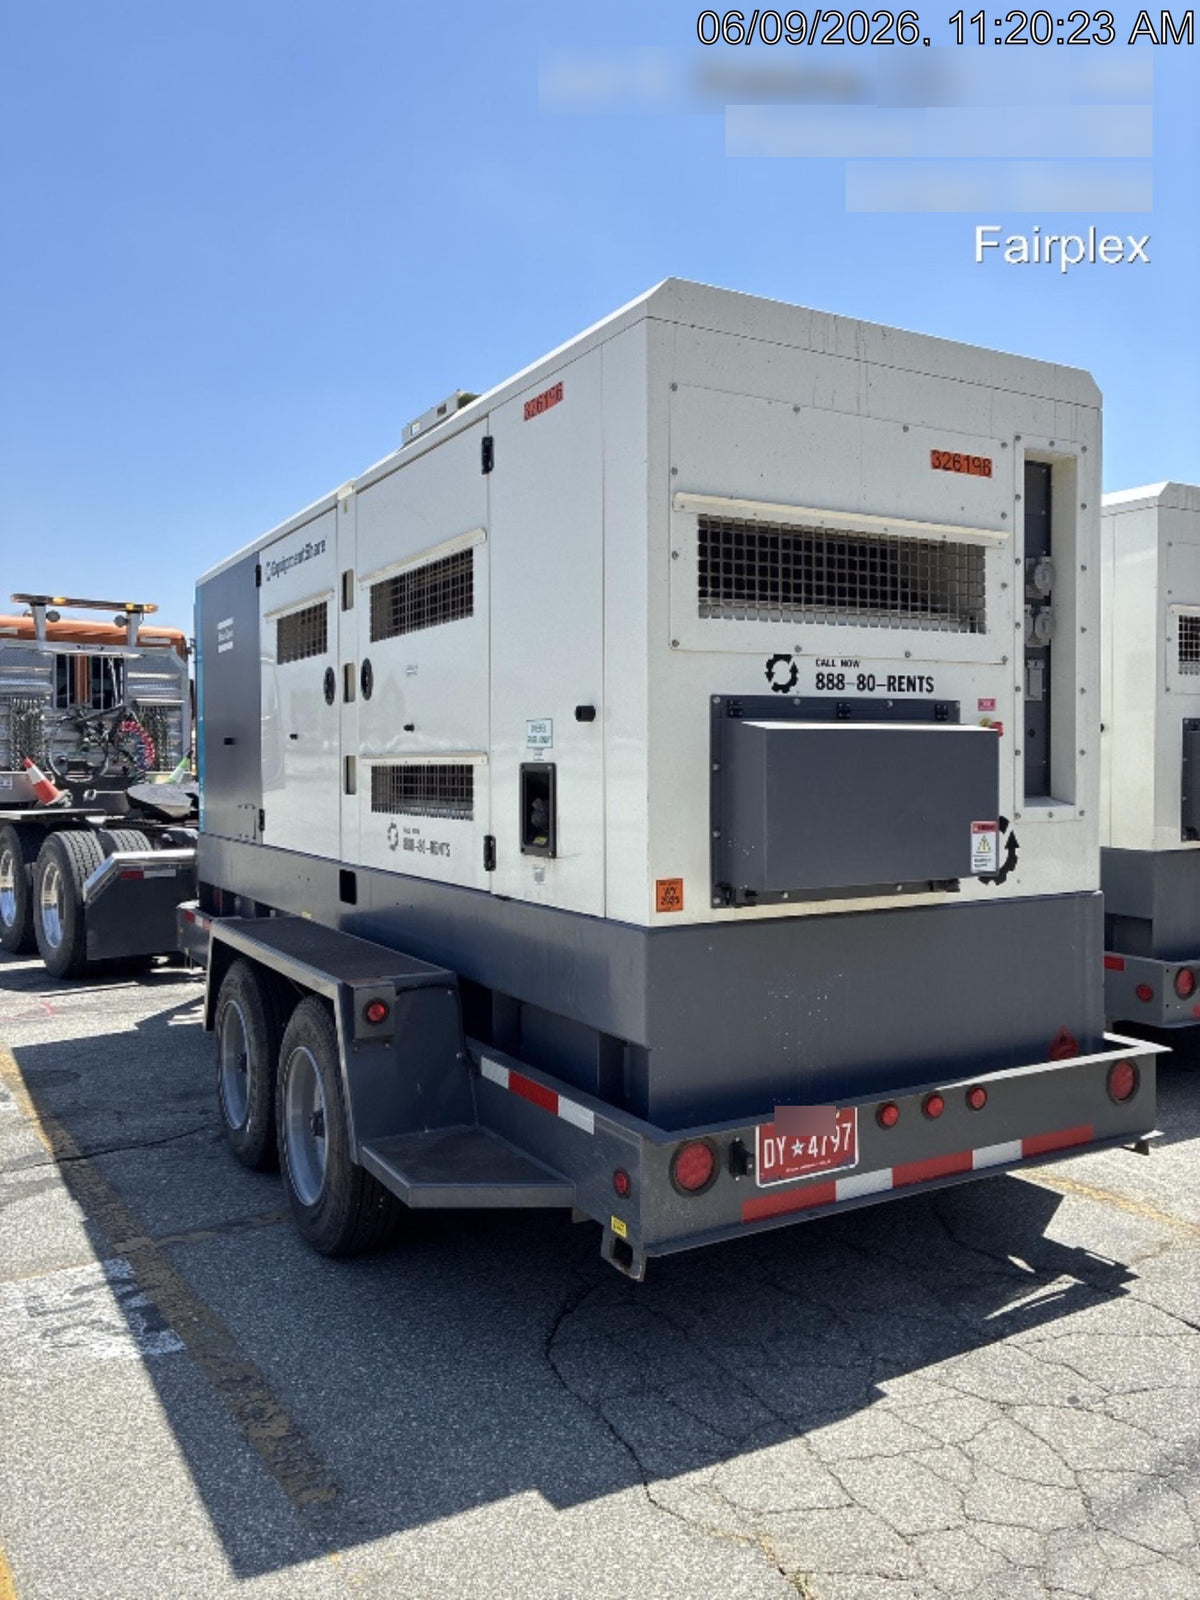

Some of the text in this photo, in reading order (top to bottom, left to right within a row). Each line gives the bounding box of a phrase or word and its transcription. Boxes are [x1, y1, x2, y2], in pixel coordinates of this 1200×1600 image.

[931, 449, 992, 478] 326196
[815, 658, 859, 668] CALL NOW
[815, 673, 934, 693] 888-80-RENTS
[764, 1135, 786, 1169] DY
